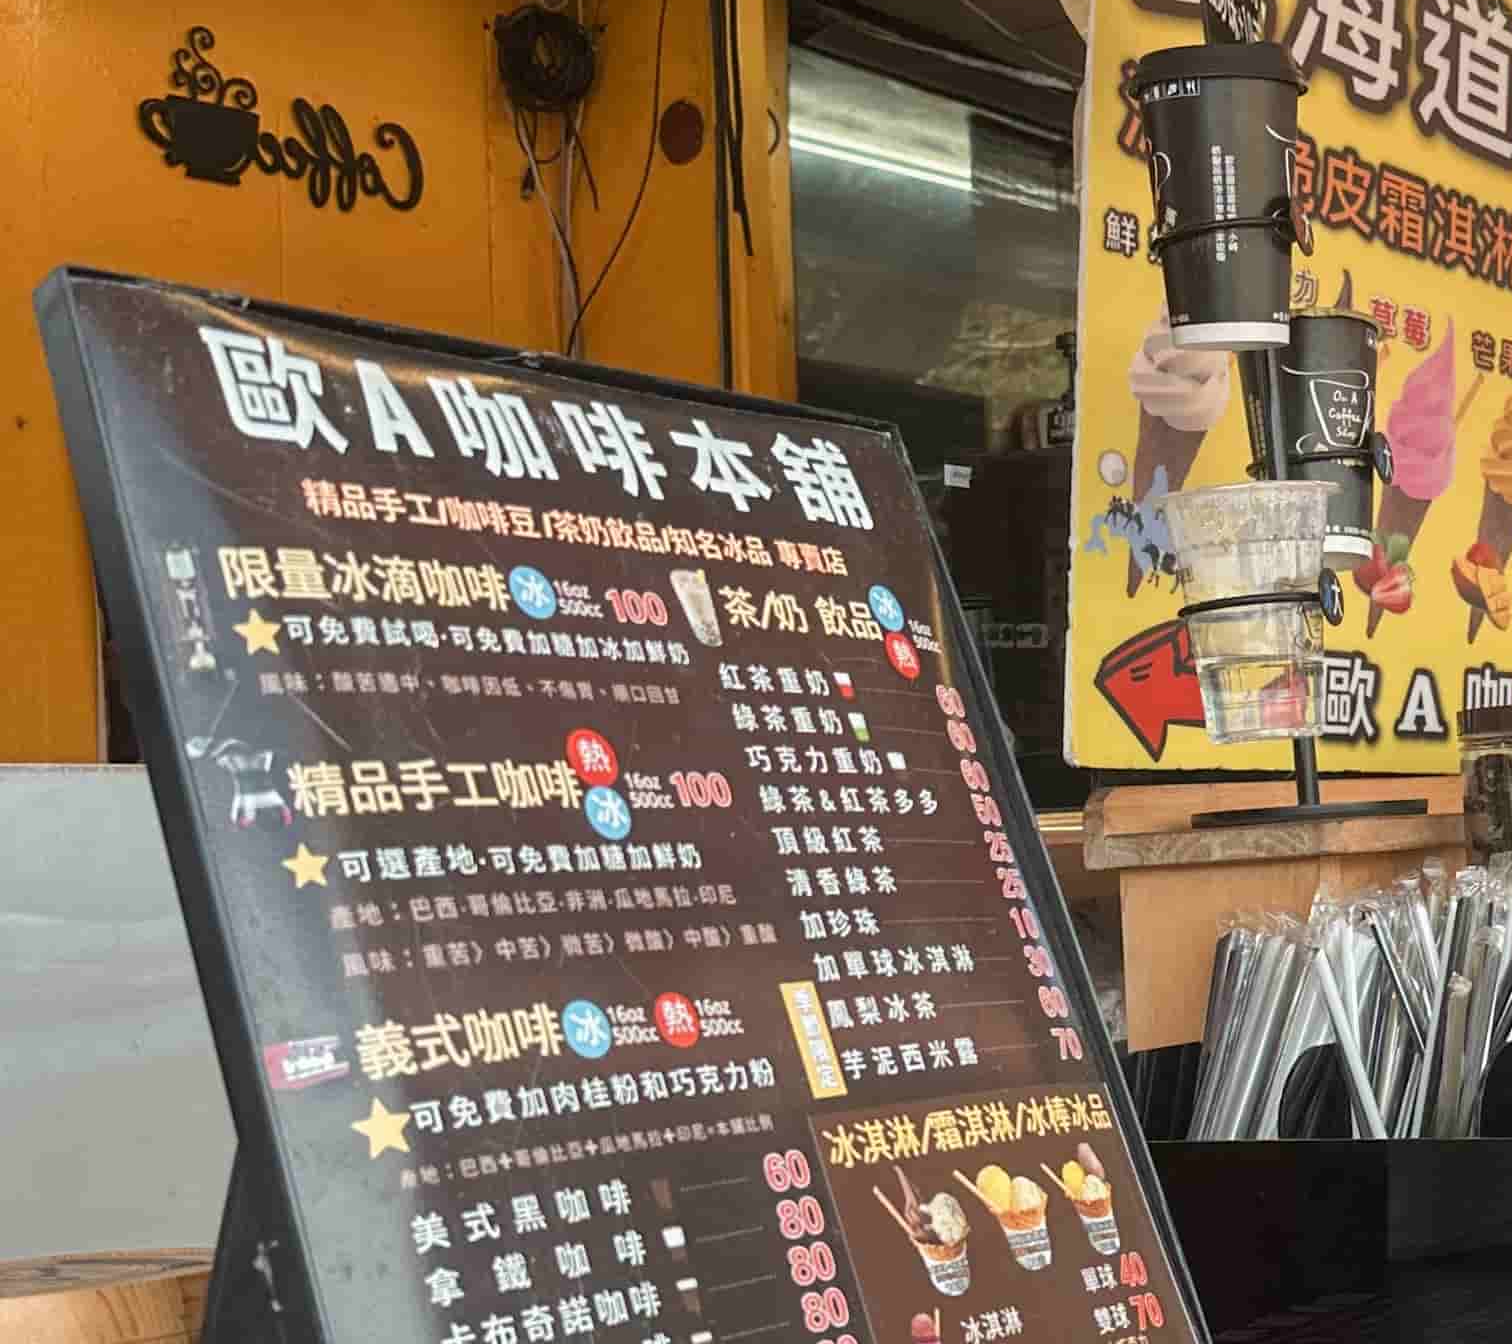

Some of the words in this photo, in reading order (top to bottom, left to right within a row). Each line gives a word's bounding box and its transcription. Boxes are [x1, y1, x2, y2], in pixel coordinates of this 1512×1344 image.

[1369, 294, 1431, 352] 草莓
[198, 325, 875, 531] 歐A咖啡本舖
[775, 538, 849, 577] 專賣店
[217, 545, 511, 613] 限量冰滴咖啡
[519, 576, 551, 610] 冰
[552, 580, 592, 600] 16oz
[557, 598, 604, 620] 500cc
[605, 587, 669, 627] 100
[717, 583, 809, 635] 茶/奶
[814, 595, 884, 642] 飲品
[719, 661, 831, 697] 紅茶重奶
[732, 702, 844, 737] 綠茶重奶
[576, 736, 613, 774] 熱
[744, 743, 884, 777] 巧克力重奶
[287, 758, 583, 819] 精品手工咖啡
[624, 772, 662, 792] 16oz
[628, 790, 677, 811] 500cc
[669, 769, 735, 810] 100
[759, 785, 939, 817] 綠茶&紅茶多多
[595, 793, 625, 831] 冰
[771, 825, 885, 857] 頂級紅茶
[785, 865, 898, 899] 清香綠茶
[800, 907, 882, 942] 加珍珠
[1008, 906, 1041, 939] 10
[813, 944, 976, 984] 加單球冰淇淋
[606, 1003, 648, 1027] 16oz
[659, 999, 697, 1040] 熱
[694, 997, 732, 1019] 16oz
[698, 1016, 746, 1039] 500cc
[826, 991, 938, 1031] 鳳梨冰茶
[353, 1001, 565, 1084] 義式咖啡
[568, 1009, 609, 1051] 冰
[611, 1024, 659, 1048] 500cc
[840, 1036, 980, 1081] 芋泥西米露
[409, 1056, 776, 1136] 可免費加肉桂粉和巧克力粉
[821, 1092, 1115, 1171] 冰淇淋/霜淇淋/冰棒冰品
[762, 1147, 813, 1194] 60
[409, 1178, 634, 1256] 美式黑咖啡
[775, 1193, 827, 1241] 80
[424, 1229, 648, 1309] 拿鐵咖啡
[787, 1239, 838, 1287] 80
[1079, 1261, 1119, 1295] 單球
[1118, 1250, 1150, 1290] 40
[800, 1285, 851, 1335] 80
[1127, 1291, 1165, 1333] 70
